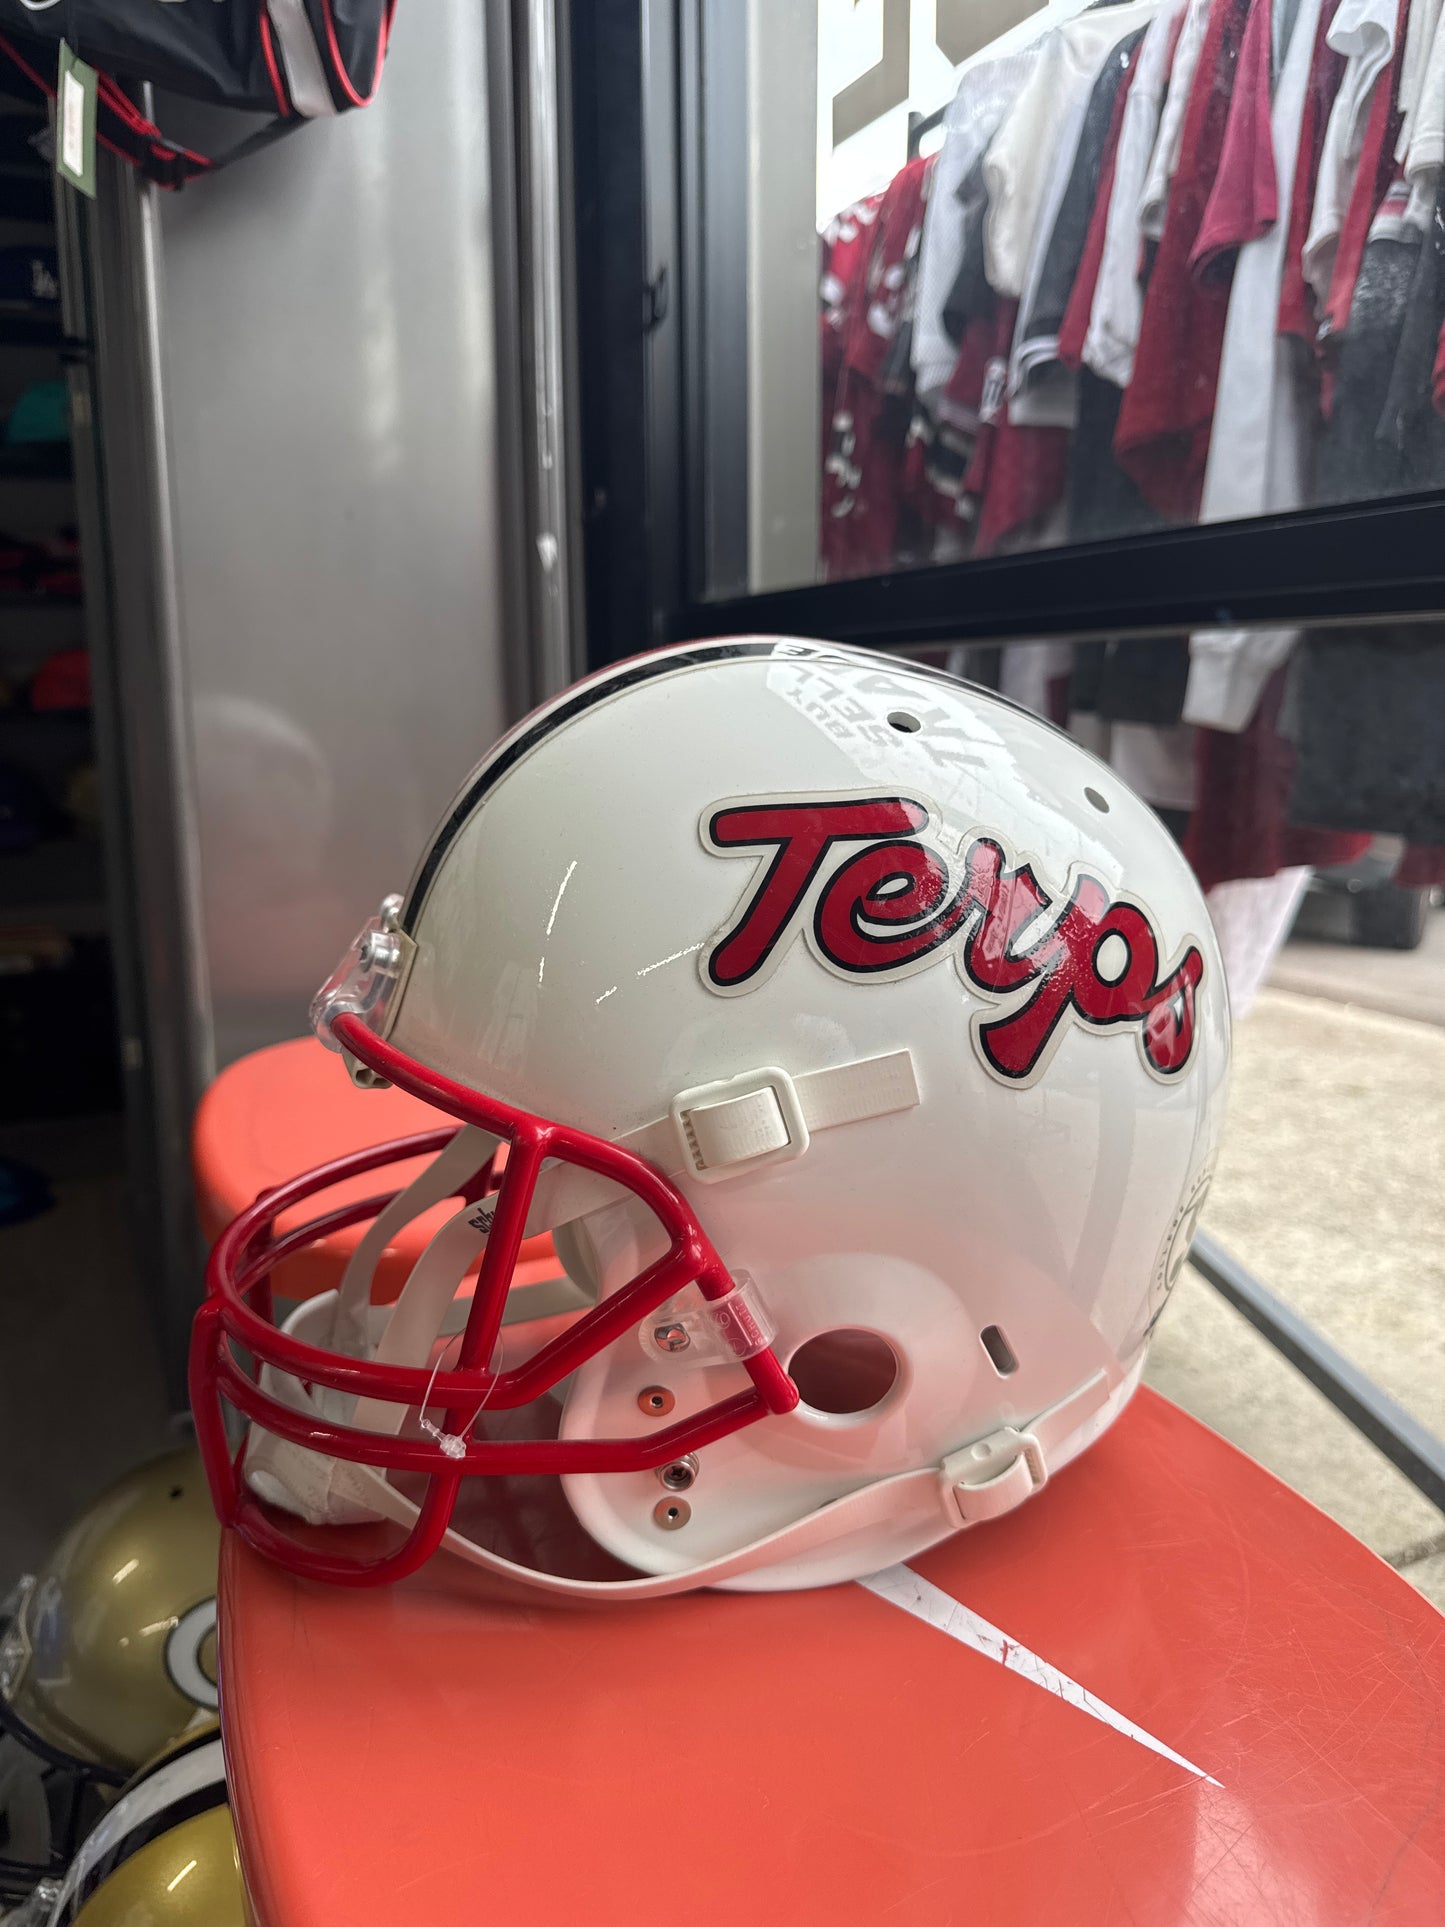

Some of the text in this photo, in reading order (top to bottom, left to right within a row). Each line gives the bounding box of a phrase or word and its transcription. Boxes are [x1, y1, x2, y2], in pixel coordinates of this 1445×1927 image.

[786, 688, 854, 739] BUY
[790, 664, 903, 748] SELL
[709, 797, 1204, 1079] Terps
[734, 1302, 764, 1346] SCHUTT
